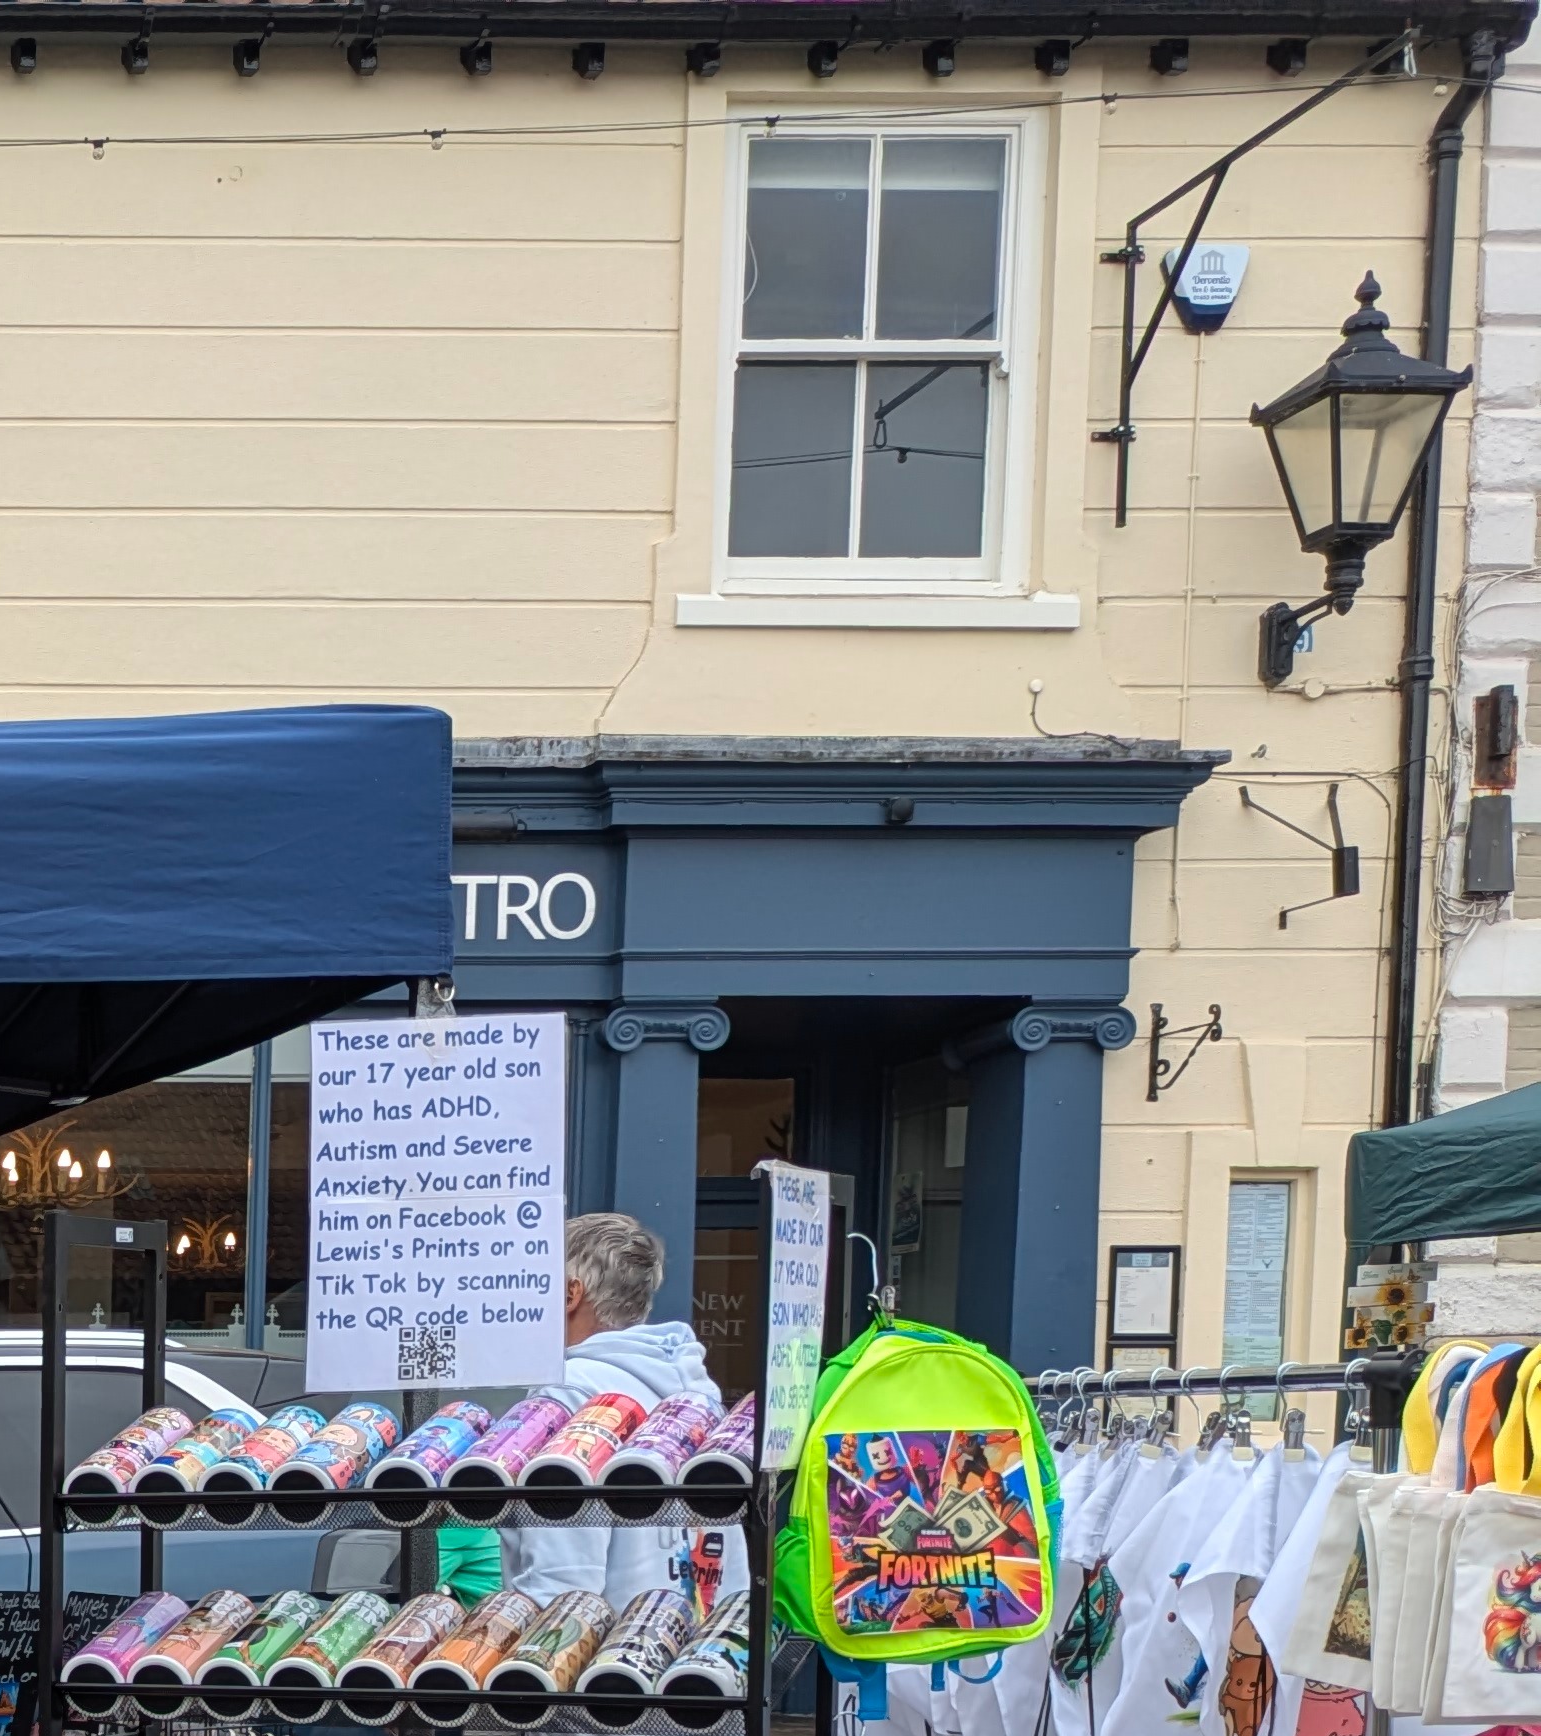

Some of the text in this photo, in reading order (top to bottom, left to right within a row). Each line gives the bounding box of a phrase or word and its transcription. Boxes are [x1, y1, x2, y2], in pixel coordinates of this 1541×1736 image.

[318, 1023, 540, 1051] These are made by
[318, 1057, 540, 1089] our 17 year old son
[319, 1096, 499, 1124] who has ADHD,
[317, 1135, 532, 1162] Autism and Severe
[315, 1165, 550, 1200] Anxiety. You can find
[319, 1201, 541, 1231] him on Facebook @
[317, 1238, 549, 1262] Lewis's Prints or on
[316, 1269, 550, 1298] Tik Tok by scanning
[785, 1261, 805, 1286] YEAR
[316, 1302, 544, 1331] the QR code below
[878, 1552, 996, 1591] FORTNITE
[67, 1596, 109, 1623] Magnets
[11, 1633, 34, 1662] £4
[20, 1672, 37, 1683] or
